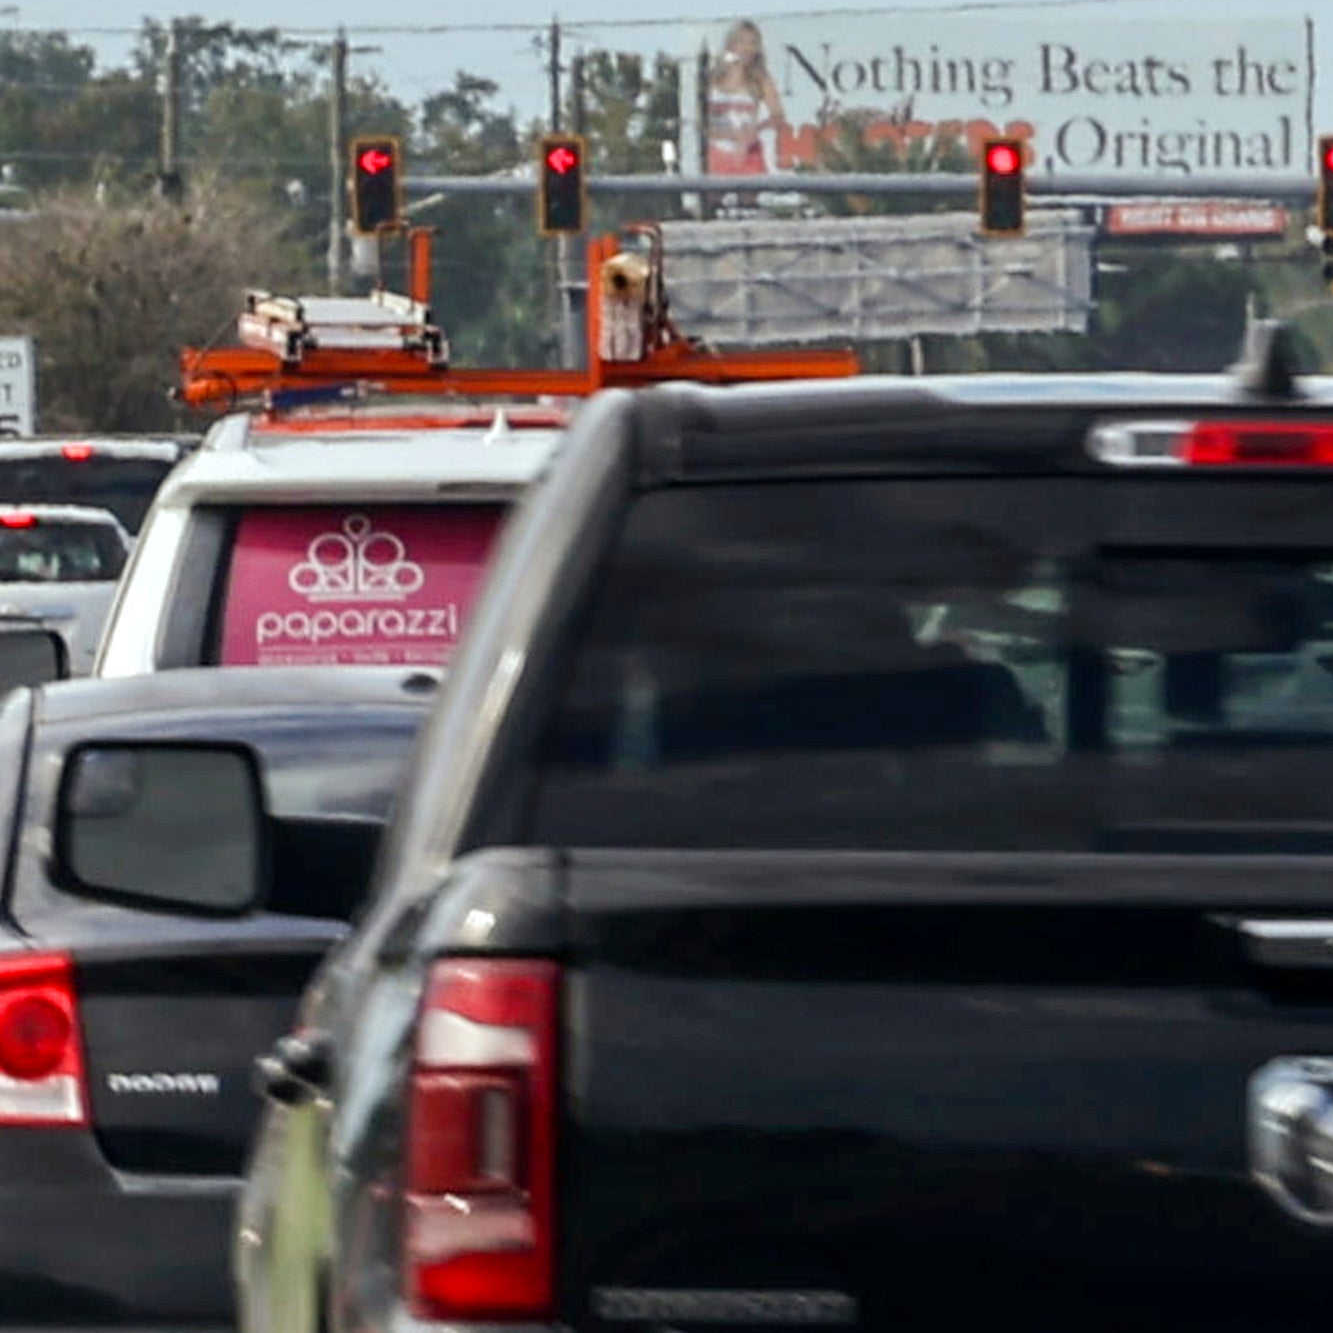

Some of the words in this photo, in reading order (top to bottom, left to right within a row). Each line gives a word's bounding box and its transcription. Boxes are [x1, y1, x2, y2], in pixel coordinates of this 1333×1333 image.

[783, 44, 1013, 104] Nothing
[1040, 43, 1191, 97] Beats
[1211, 45, 1297, 96] the
[1055, 116, 1291, 176] Original
[256, 602, 457, 644] paparazzi
